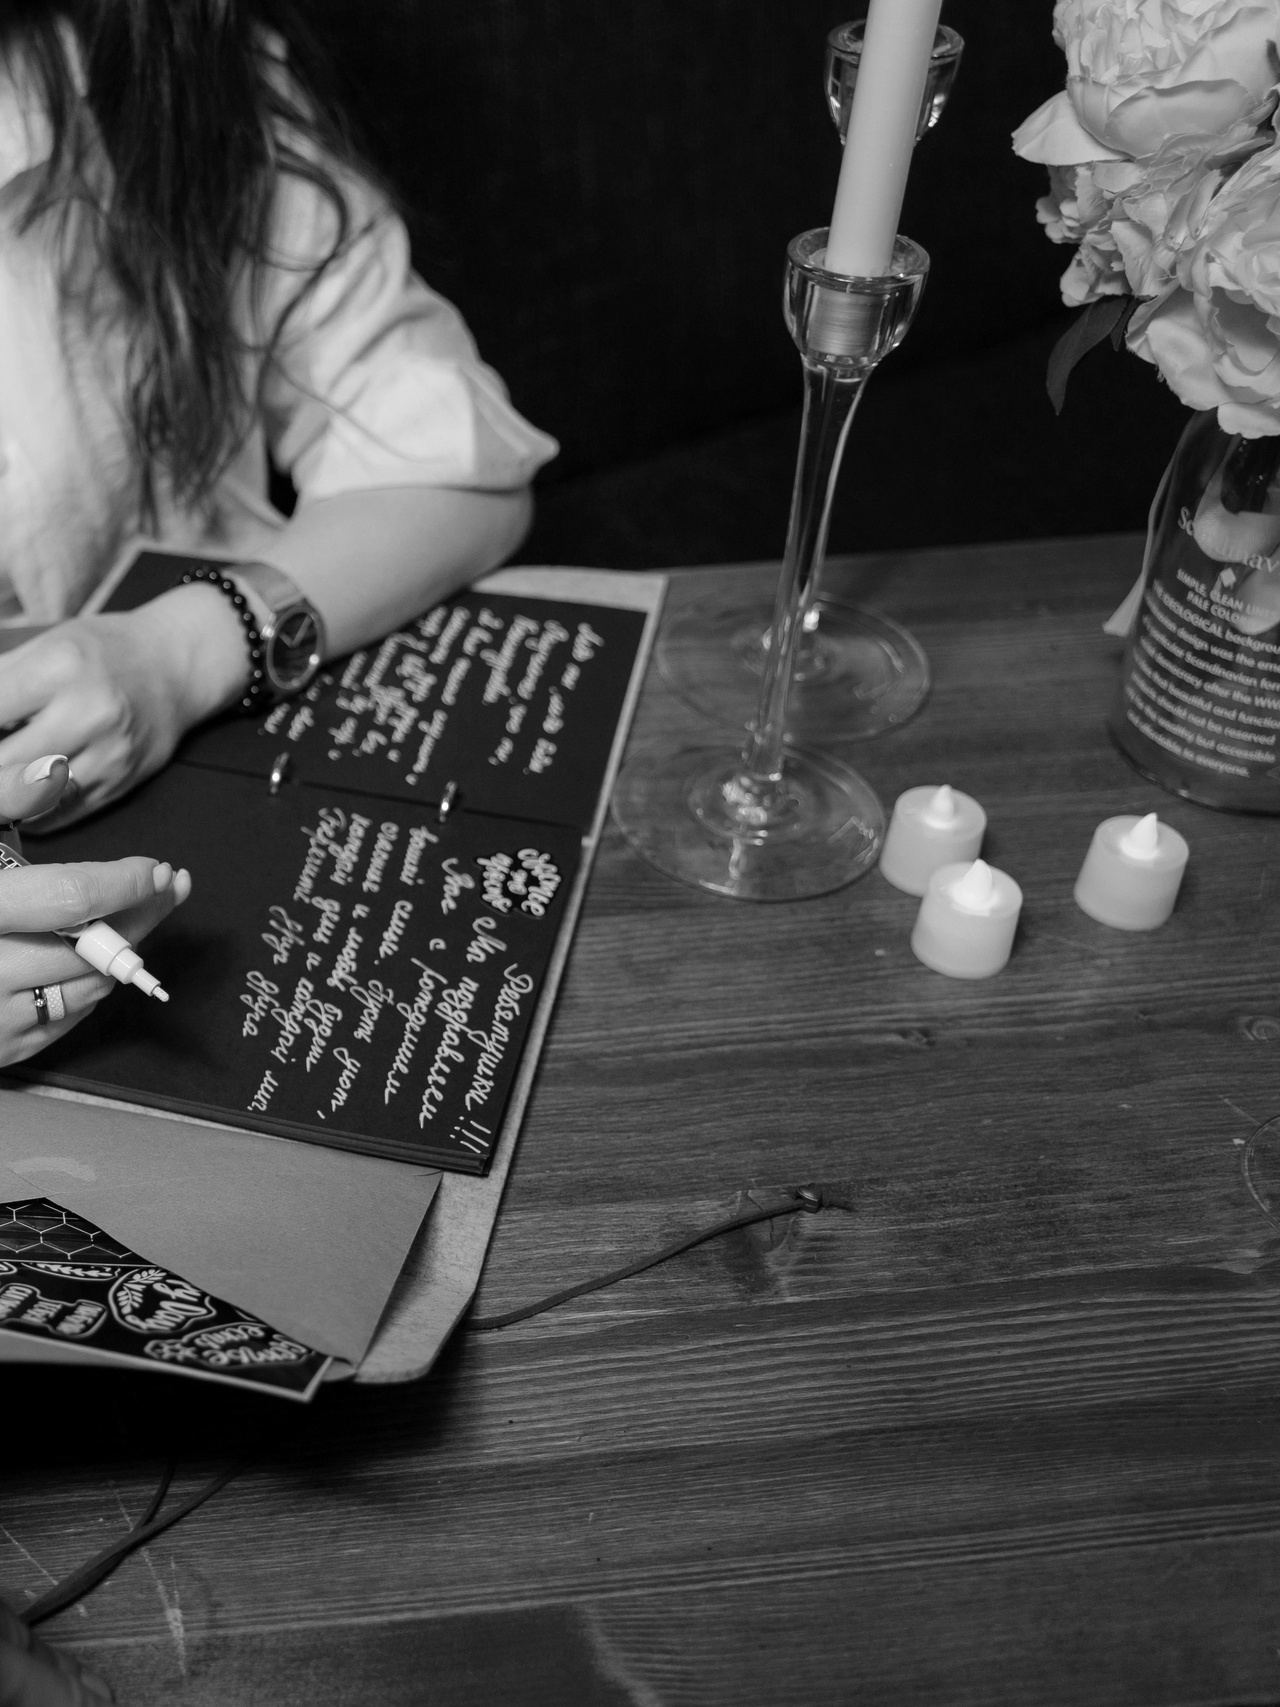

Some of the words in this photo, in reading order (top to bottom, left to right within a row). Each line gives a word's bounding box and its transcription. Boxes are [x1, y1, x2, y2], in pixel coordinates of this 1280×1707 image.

[1187, 590, 1210, 612] PALE
[1210, 589, 1243, 611] CLEAN
[1177, 627, 1209, 651] design
[1210, 645, 1234, 661] was
[1235, 653, 1255, 668] the
[1257, 660, 1280, 674] eme
[1225, 629, 1280, 655] backgrou
[1185, 651, 1258, 687] Scandinavian
[1168, 682, 1213, 712] beautiful
[1213, 705, 1238, 721] and
[1237, 710, 1280, 730] functio
[1203, 681, 1231, 698] after
[1231, 690, 1252, 705] the
[1254, 696, 1280, 711] WW
[1187, 713, 1207, 729] not
[1207, 718, 1224, 734] be
[1224, 727, 1276, 746] reserved
[1195, 733, 1216, 750] but
[1215, 743, 1276, 764] accessible
[419, 977, 479, 1129] поздравляем
[465, 963, 533, 1111] Ребятушки
